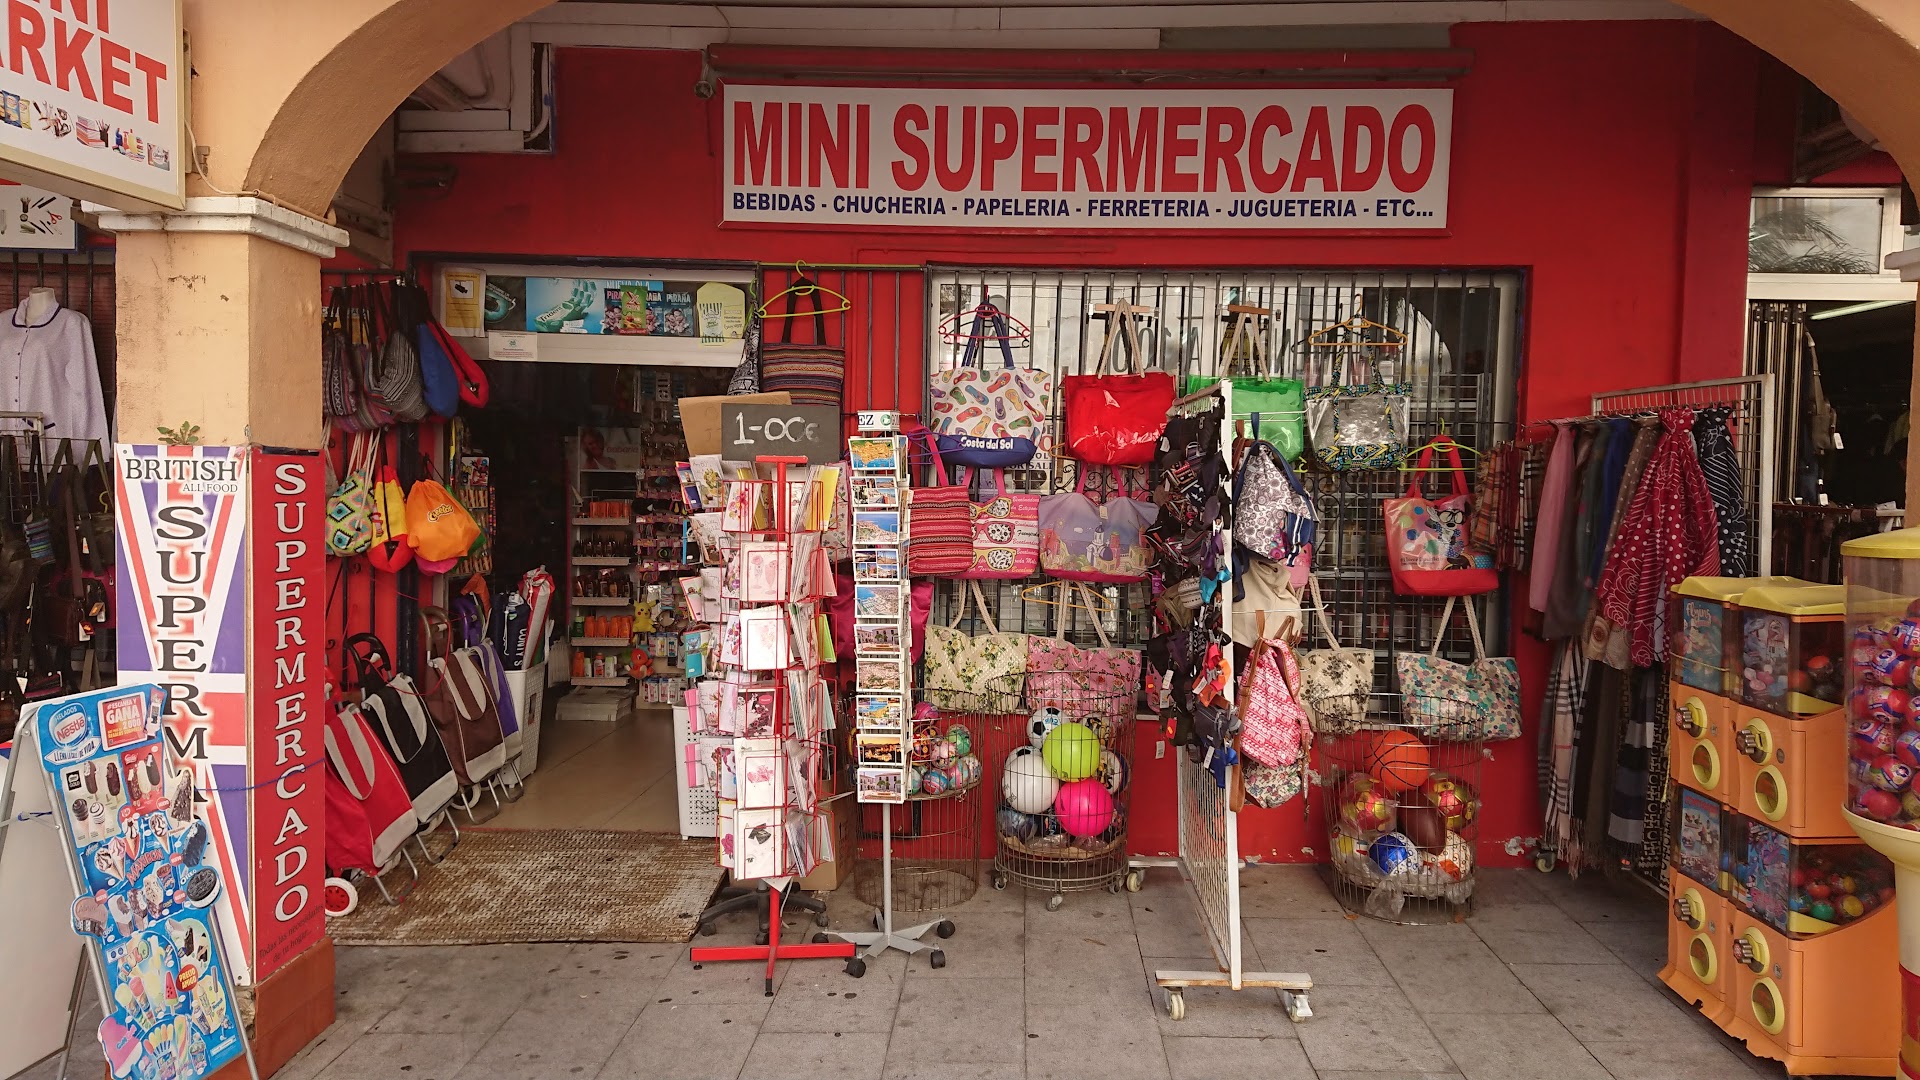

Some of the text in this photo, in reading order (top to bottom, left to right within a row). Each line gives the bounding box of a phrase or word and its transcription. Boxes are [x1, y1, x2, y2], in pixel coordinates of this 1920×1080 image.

[0, 0, 167, 125] RKET
[733, 101, 1436, 194] MINI SUPERMERCADO
[733, 192, 816, 212] BEBIDAS
[833, 195, 946, 215] CHUCHERIA
[964, 198, 1070, 217] PAPELERIA
[1087, 199, 1209, 217] FERRETERIA
[1227, 199, 1357, 217] JUGUETERIA
[1376, 199, 1433, 217] ETC...
[961, 437, 1014, 450] Costa del Sol
[125, 458, 238, 481] BRITISH
[182, 483, 238, 493] ALL FOOD
[274, 463, 309, 922] SUPERMERCADO
[54, 706, 78, 722] HELADOS
[106, 705, 140, 725] GANA
[180, 869, 198, 885] OREO
[278, 934, 287, 944] las
[178, 968, 196, 983] PRECIO
[181, 976, 197, 990] AMIGO
